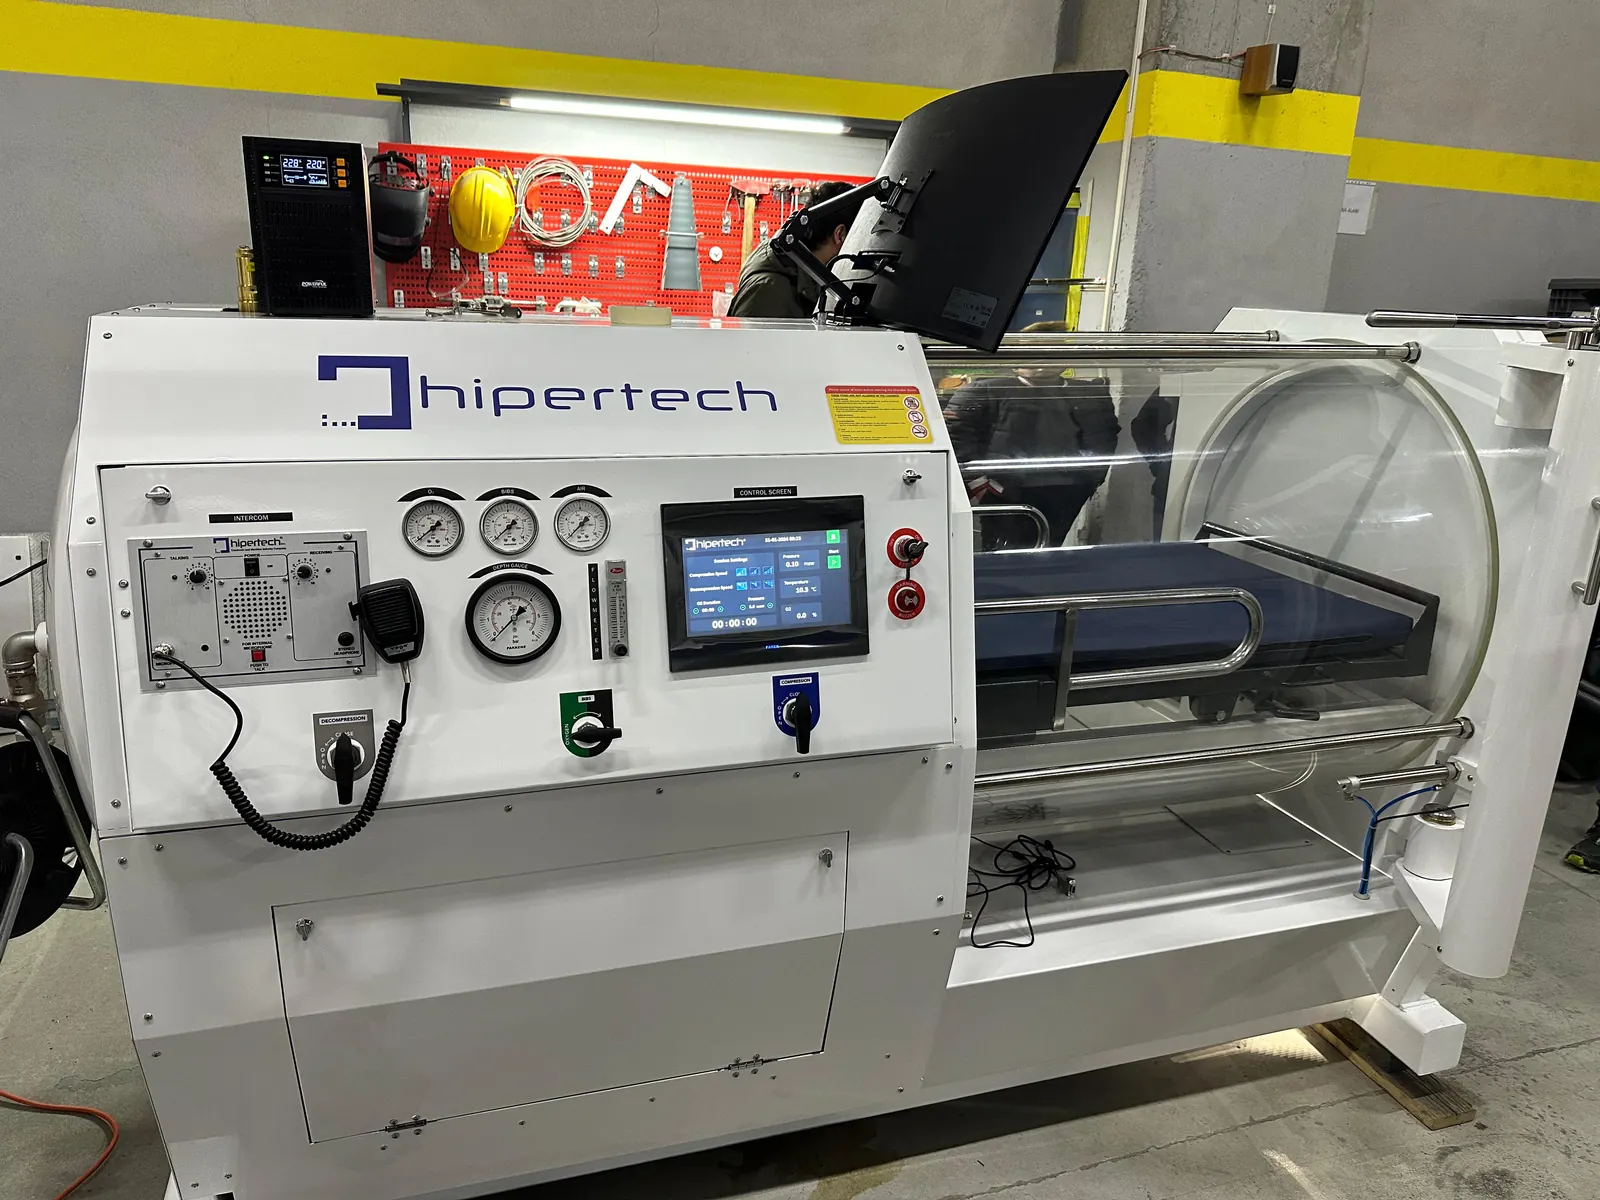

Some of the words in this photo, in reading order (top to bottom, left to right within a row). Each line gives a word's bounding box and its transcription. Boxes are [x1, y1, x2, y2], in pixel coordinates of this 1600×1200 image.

[419, 375, 778, 417] hipertech
[231, 537, 281, 548] hipertech
[696, 538, 743, 549] hipertech
[591, 567, 600, 653] FLOWMETER
[321, 716, 366, 724] DECOMPRESSION
